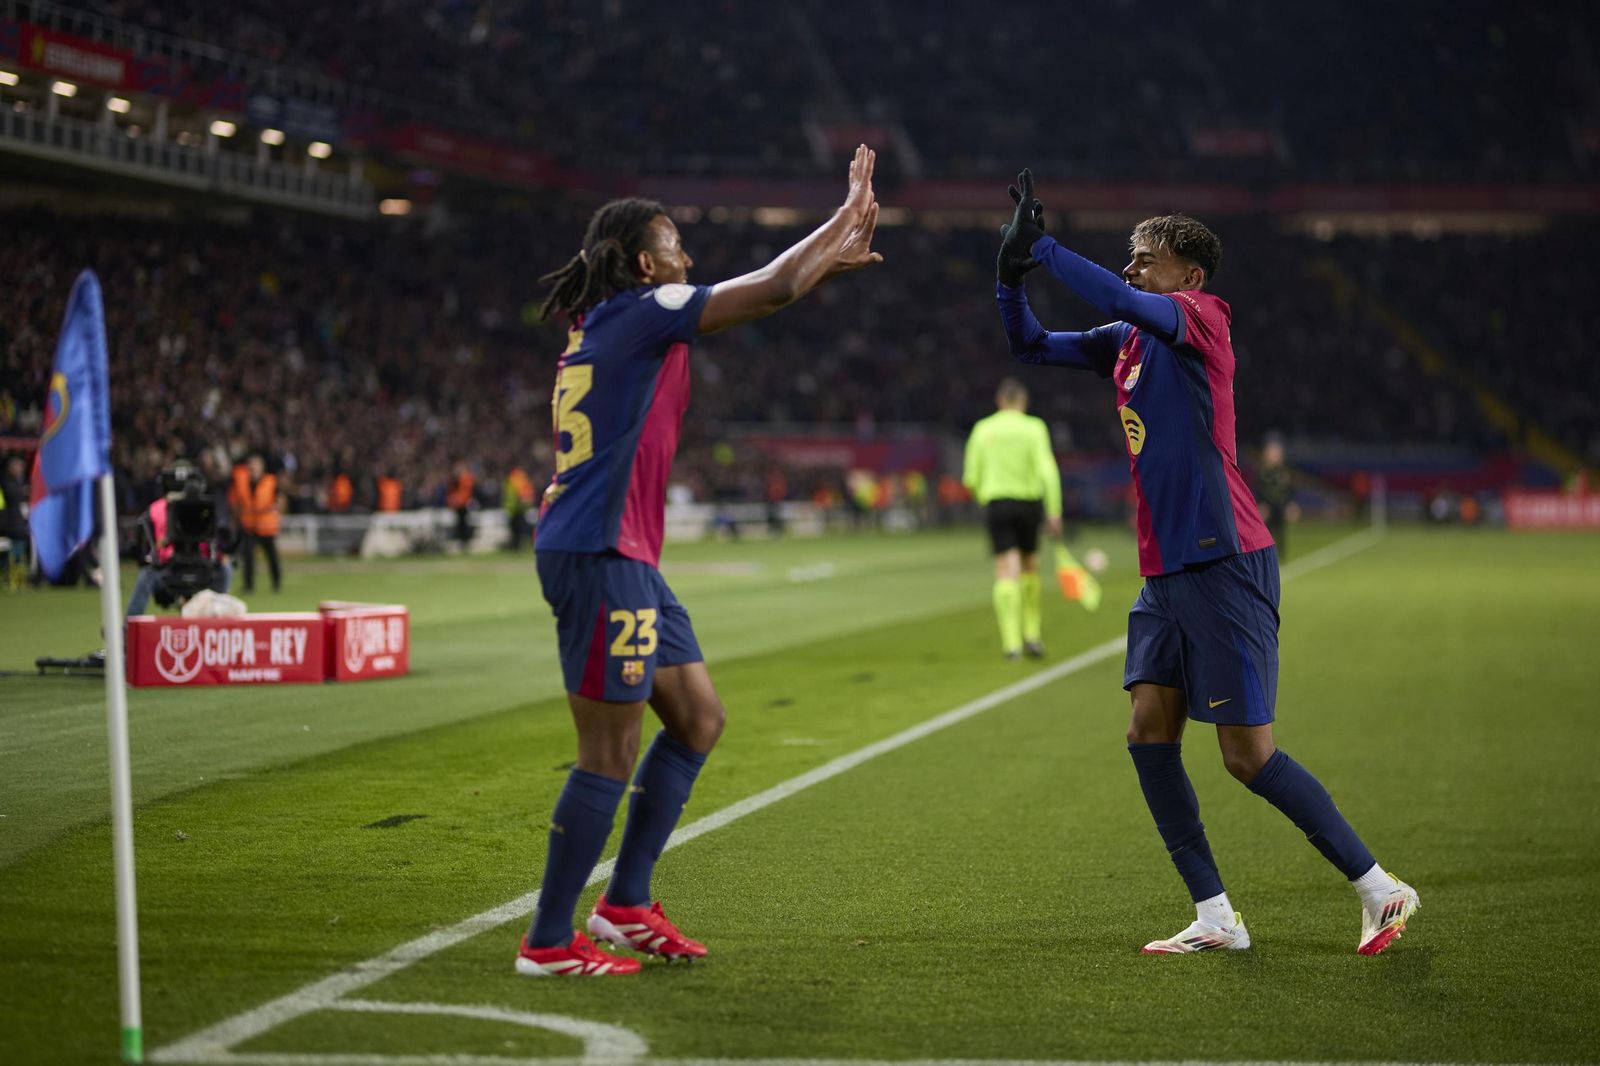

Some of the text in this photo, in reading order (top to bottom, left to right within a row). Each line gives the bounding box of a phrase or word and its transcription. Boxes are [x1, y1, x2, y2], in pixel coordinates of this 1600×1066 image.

[204, 628, 308, 666] COPA REY
[610, 608, 658, 656] 23
